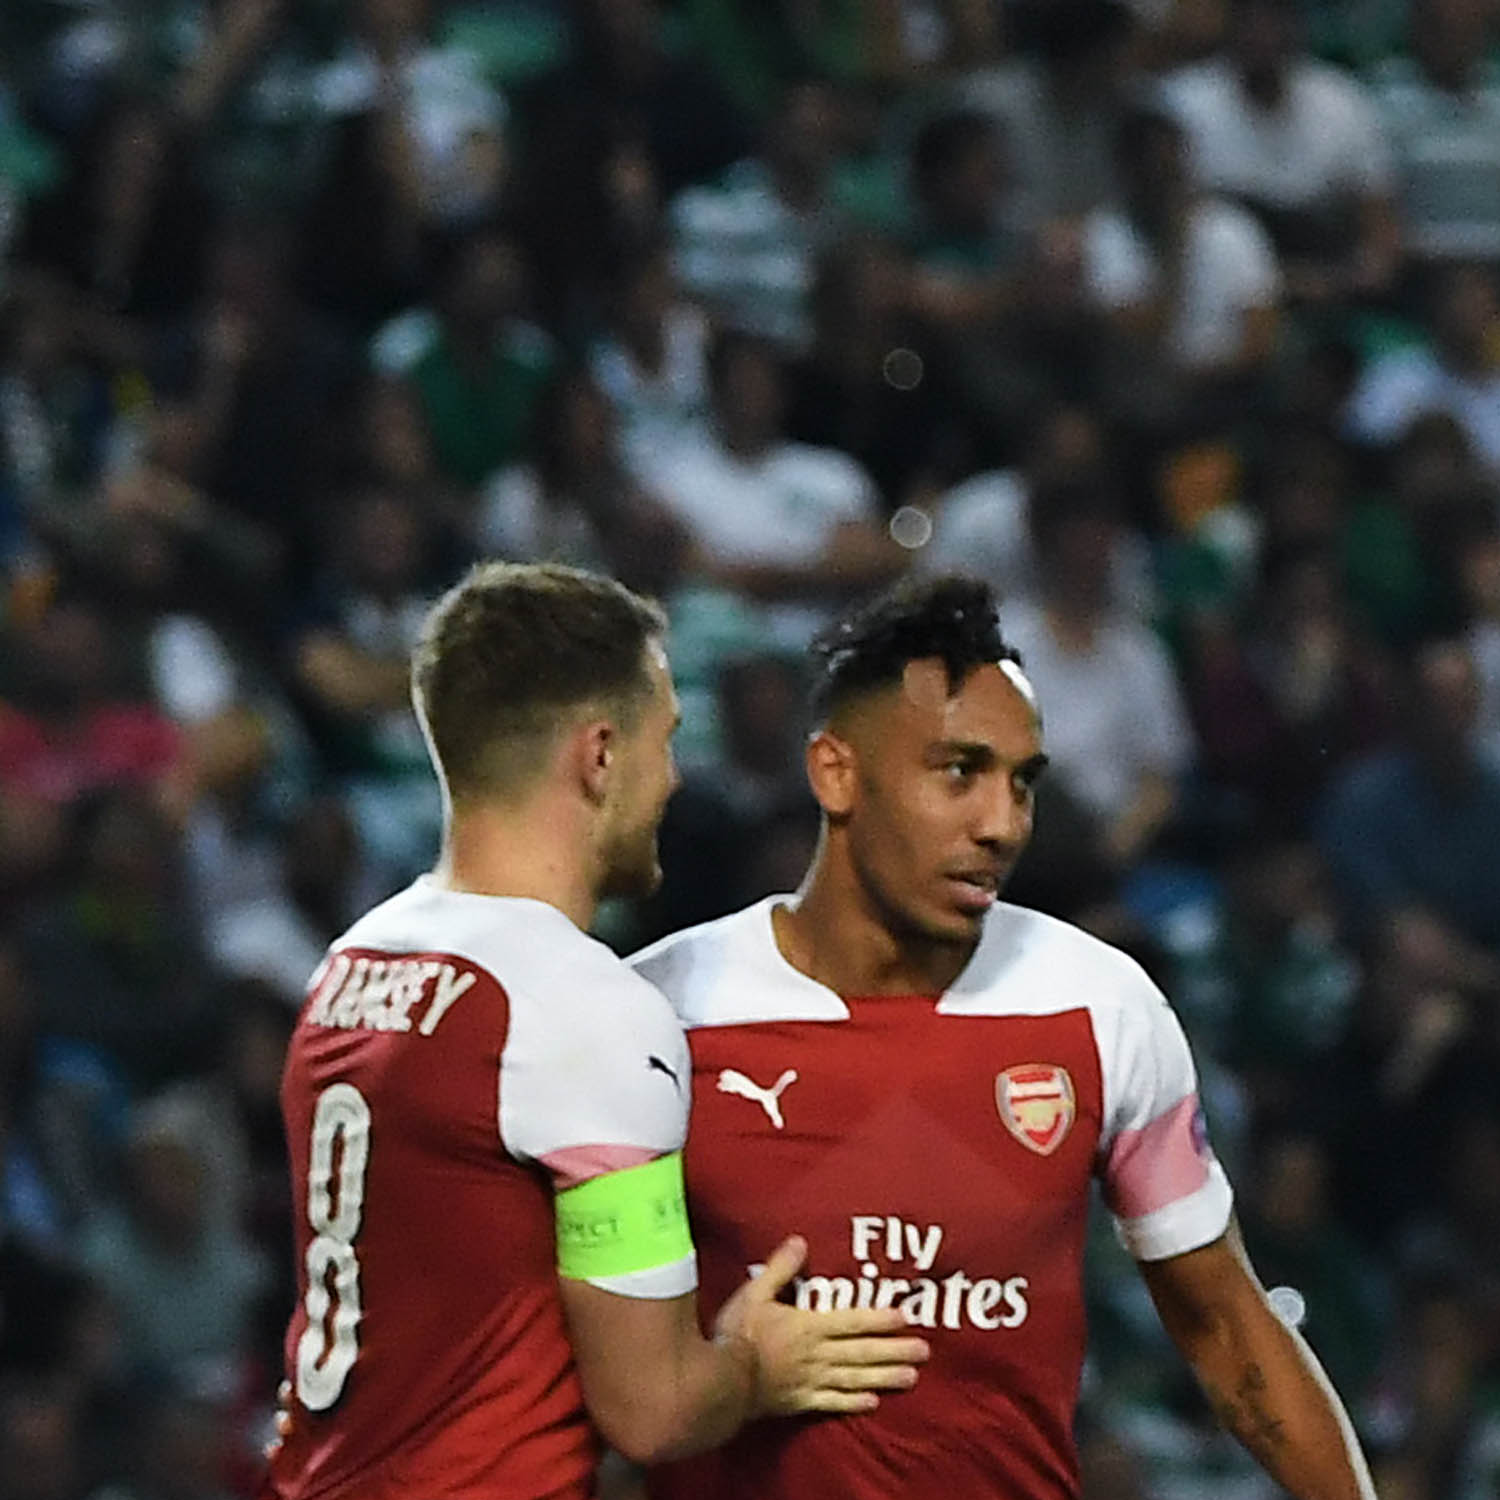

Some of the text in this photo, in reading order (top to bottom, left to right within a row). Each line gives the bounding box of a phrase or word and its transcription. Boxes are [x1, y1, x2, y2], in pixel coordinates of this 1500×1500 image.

[297, 1082, 372, 1411] 8
[852, 1216, 942, 1270] Fly
[748, 1262, 1029, 1330] mirates
